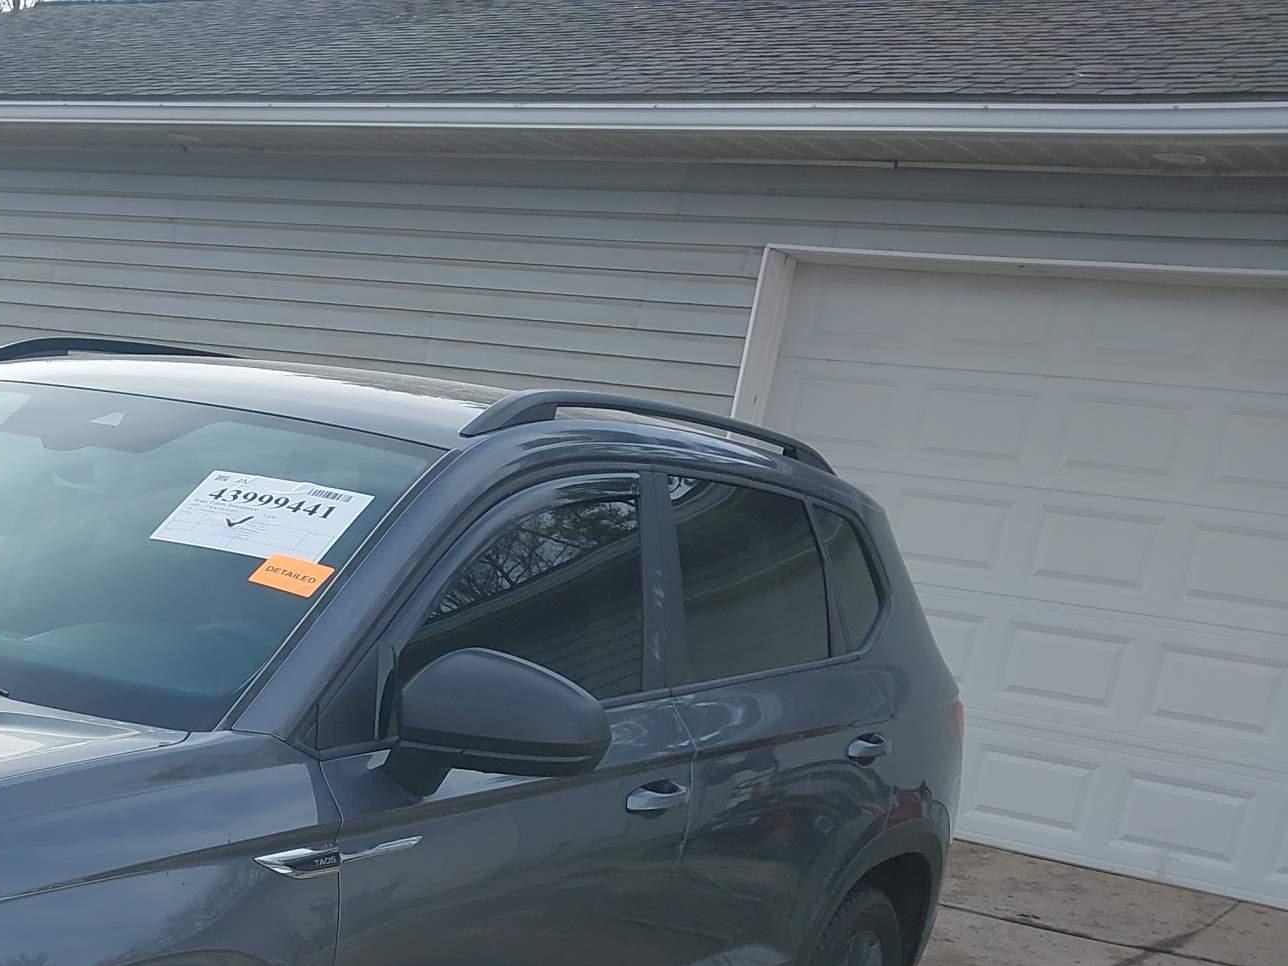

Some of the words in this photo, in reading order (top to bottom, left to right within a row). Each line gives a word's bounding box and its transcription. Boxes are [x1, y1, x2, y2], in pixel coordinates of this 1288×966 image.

[209, 487, 337, 520] 43999441
[264, 564, 317, 584] DETAILED
[314, 856, 337, 868] TAOS
